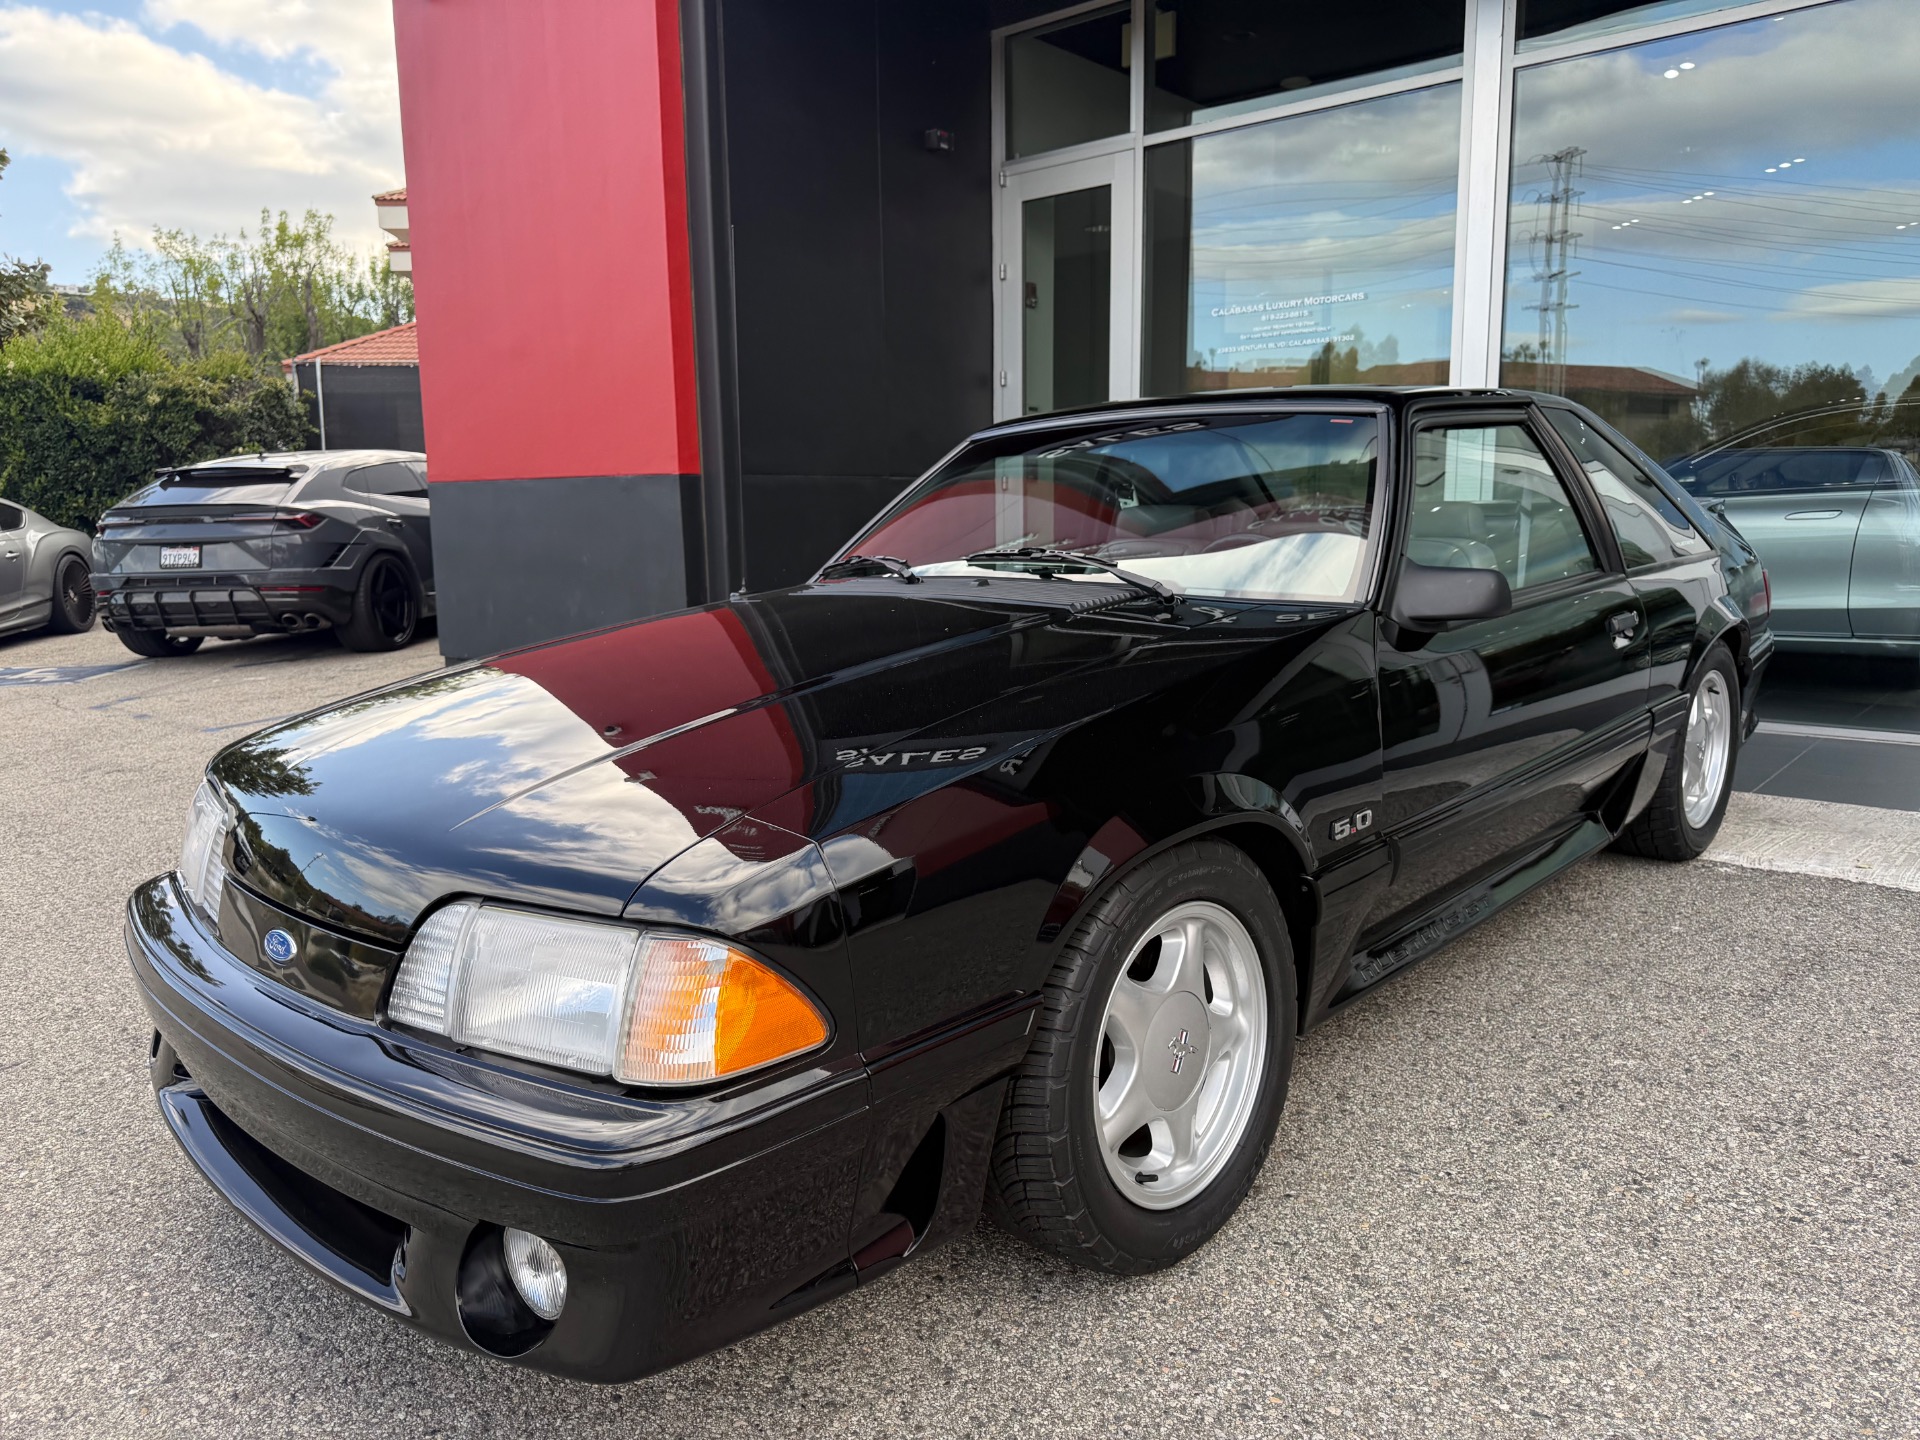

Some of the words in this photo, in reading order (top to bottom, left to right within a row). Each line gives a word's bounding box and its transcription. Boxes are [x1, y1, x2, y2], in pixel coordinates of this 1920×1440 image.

[1211, 304, 1264, 317] CALABASAS
[1265, 299, 1302, 311] LUXURY
[1304, 292, 1365, 306] MOTORCARS
[1236, 343, 1267, 352] VENTURA
[1332, 809, 1372, 840] 5.0
[269, 934, 288, 955] Ford
